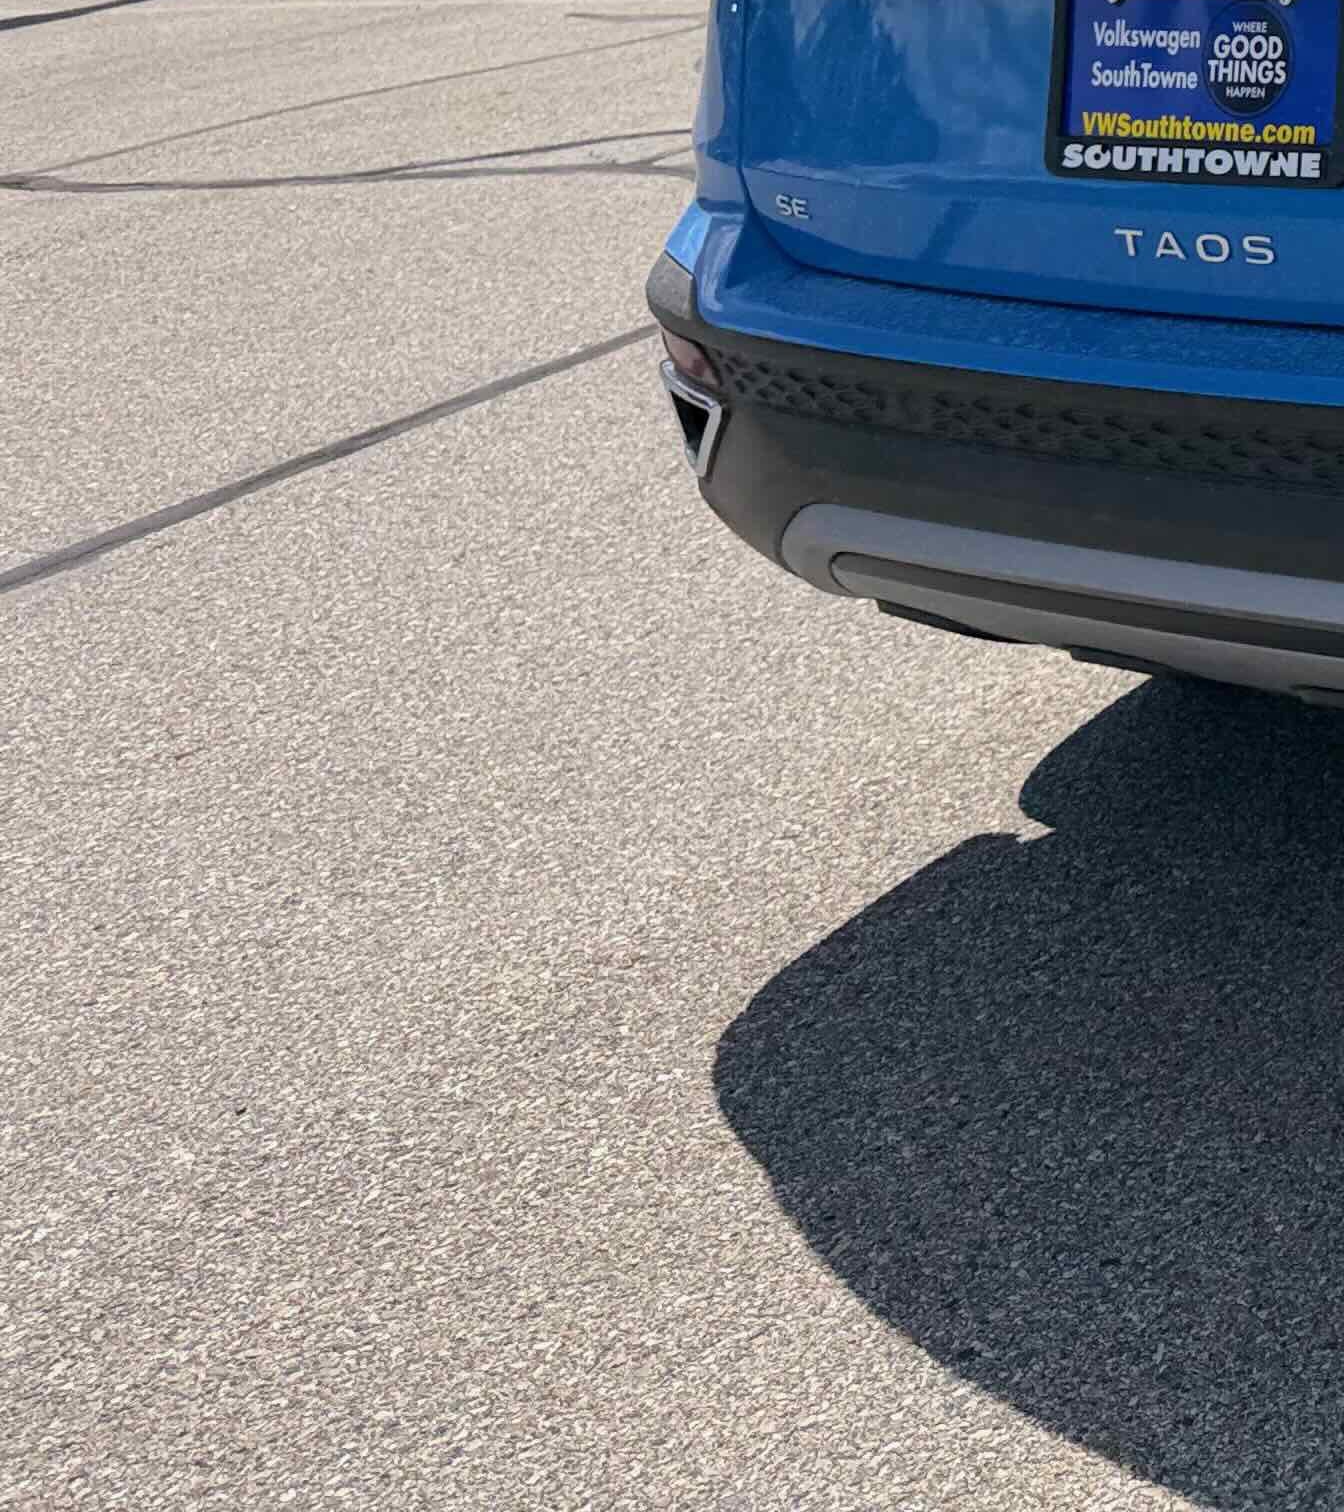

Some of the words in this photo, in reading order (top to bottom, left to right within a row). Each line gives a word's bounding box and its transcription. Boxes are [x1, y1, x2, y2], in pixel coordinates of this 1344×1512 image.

[1092, 18, 1201, 56] Volkswagen
[1231, 21, 1269, 34] WHERE
[1213, 33, 1284, 60] GOOD
[1091, 59, 1198, 89] SouthTowne
[1207, 59, 1287, 85] THINGS
[1225, 85, 1267, 100] HAPPEN
[1082, 111, 1316, 145] VWSouthtowne.com
[1061, 143, 1322, 179] SOUTHTOWNE
[775, 193, 809, 219] SE
[1113, 227, 1275, 265] TAOS
